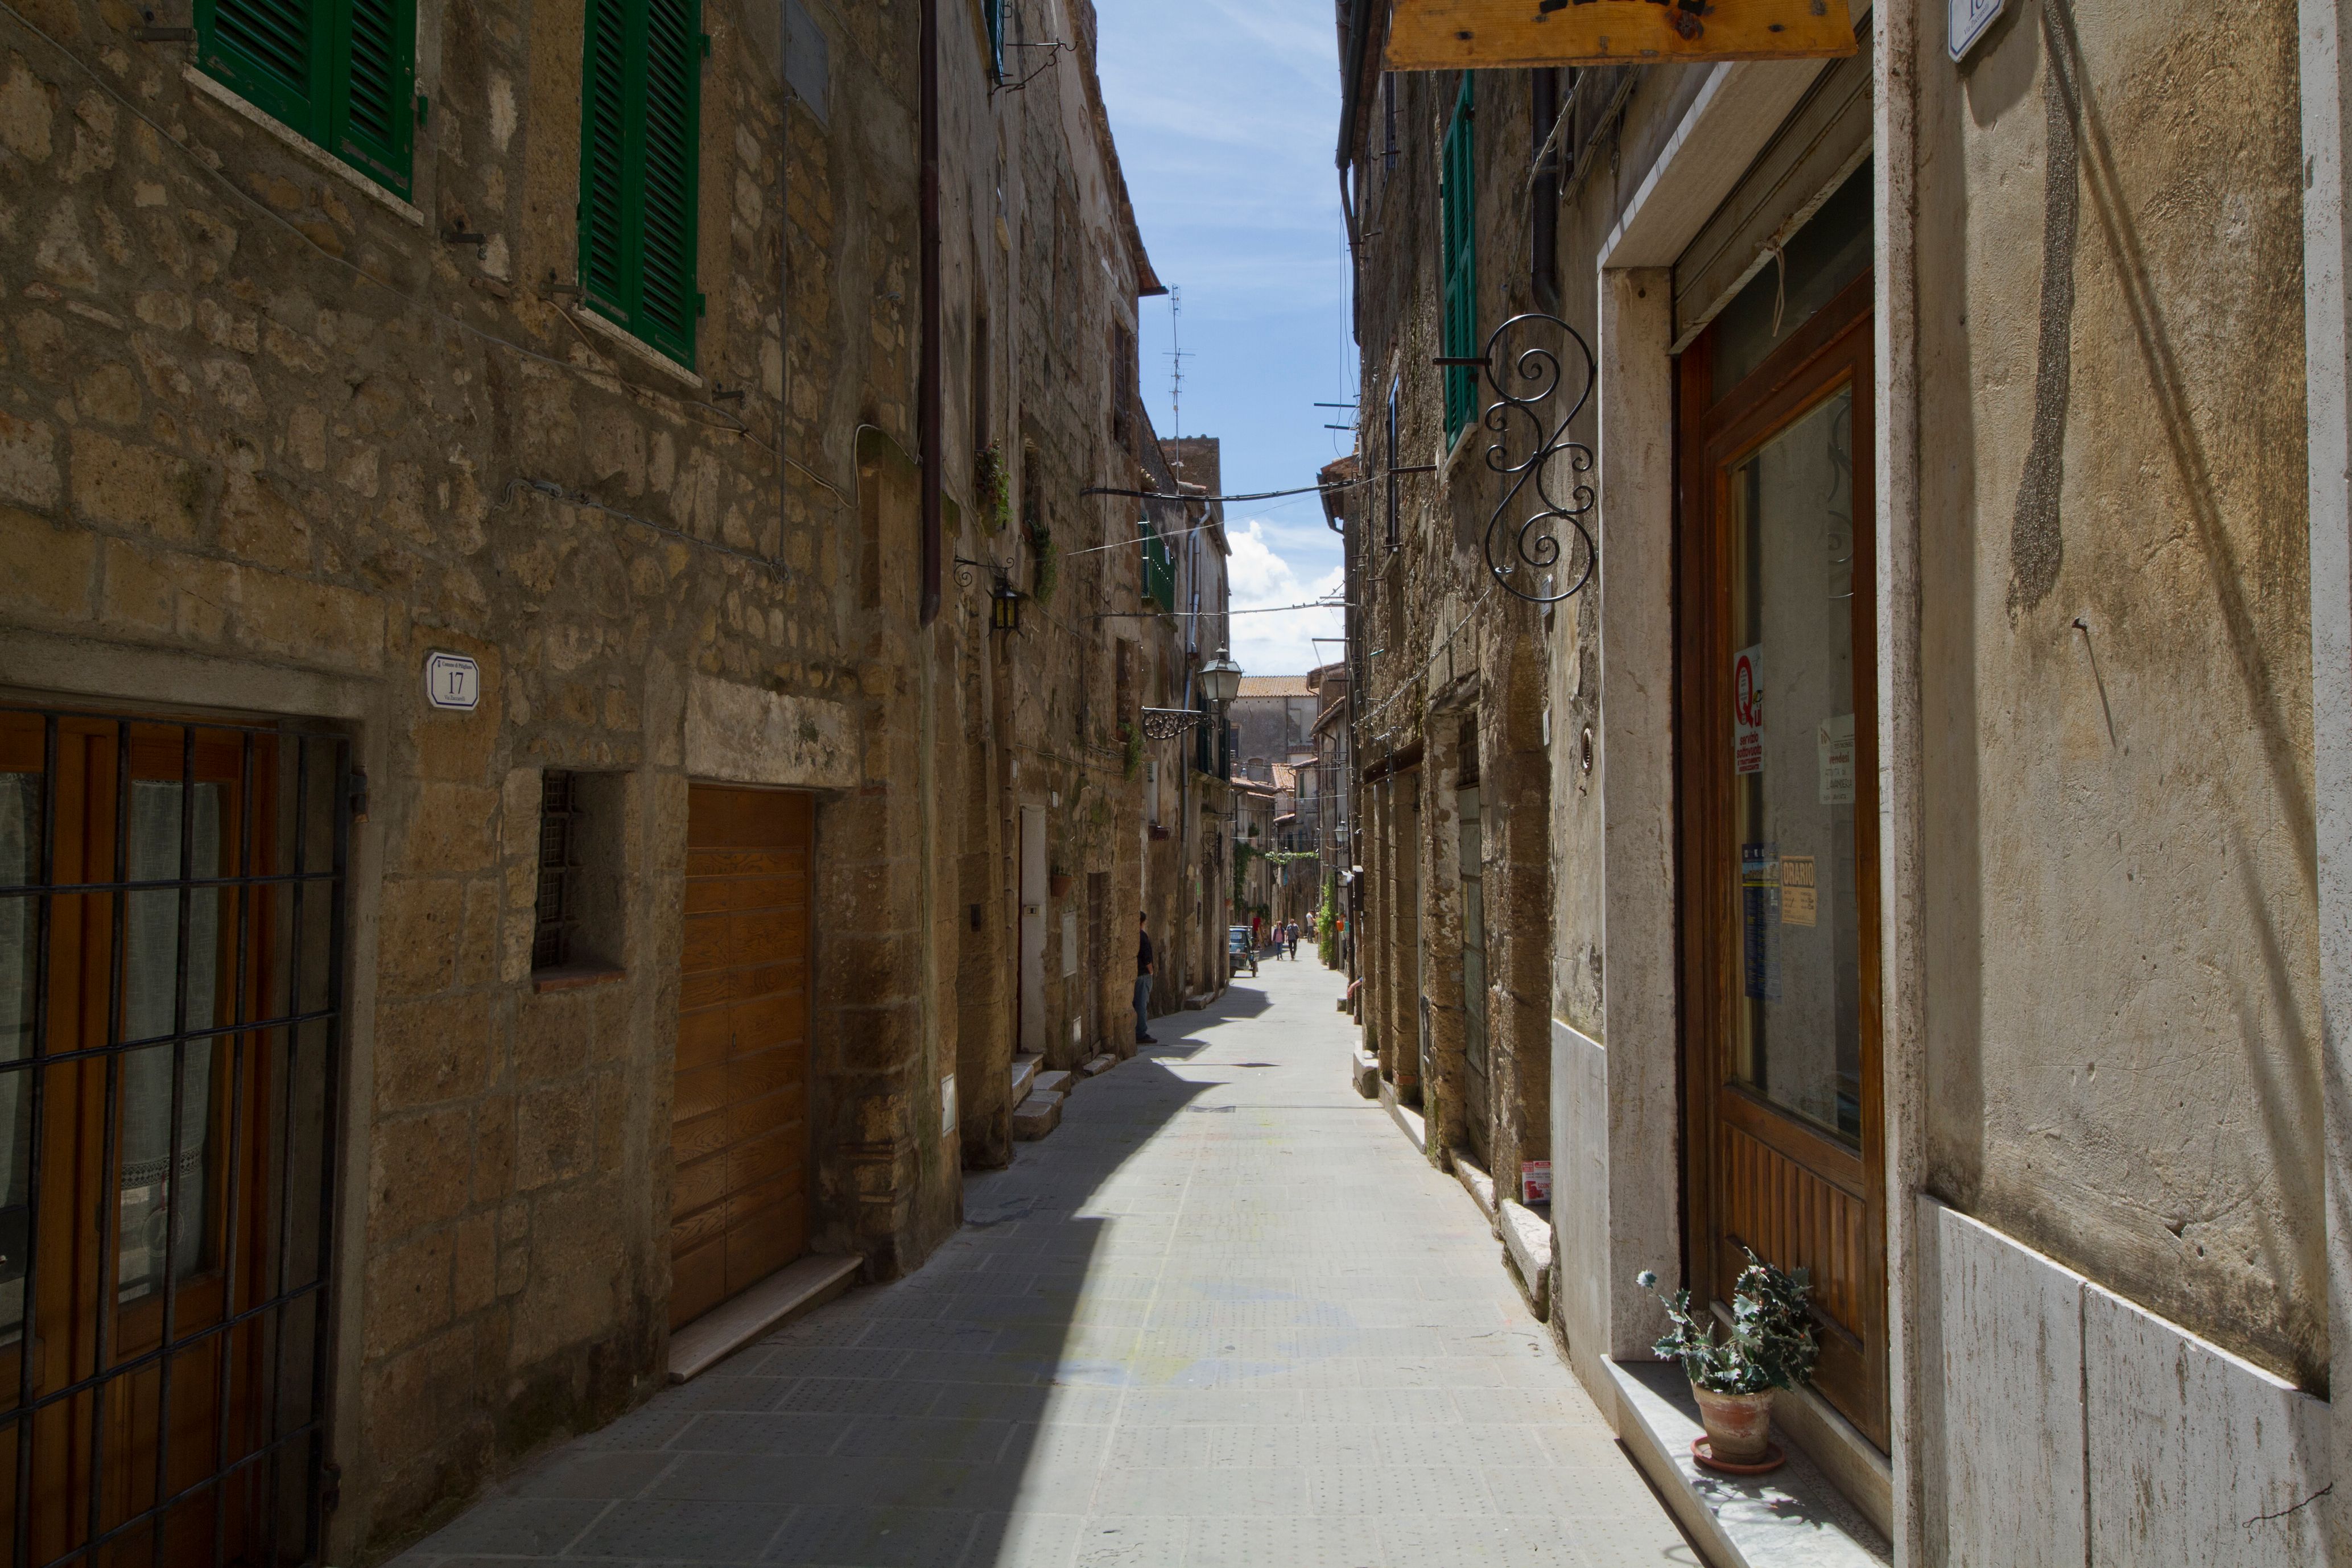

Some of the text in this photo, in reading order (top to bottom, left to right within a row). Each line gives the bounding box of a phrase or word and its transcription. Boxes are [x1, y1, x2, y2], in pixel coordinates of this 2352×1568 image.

[449, 672, 464, 694] 17
[1740, 731, 1759, 745] servizio
[1737, 744, 1762, 758] sottovuoto
[1829, 752, 1849, 764] vendesi
[1783, 862, 1815, 886] ORARIO
